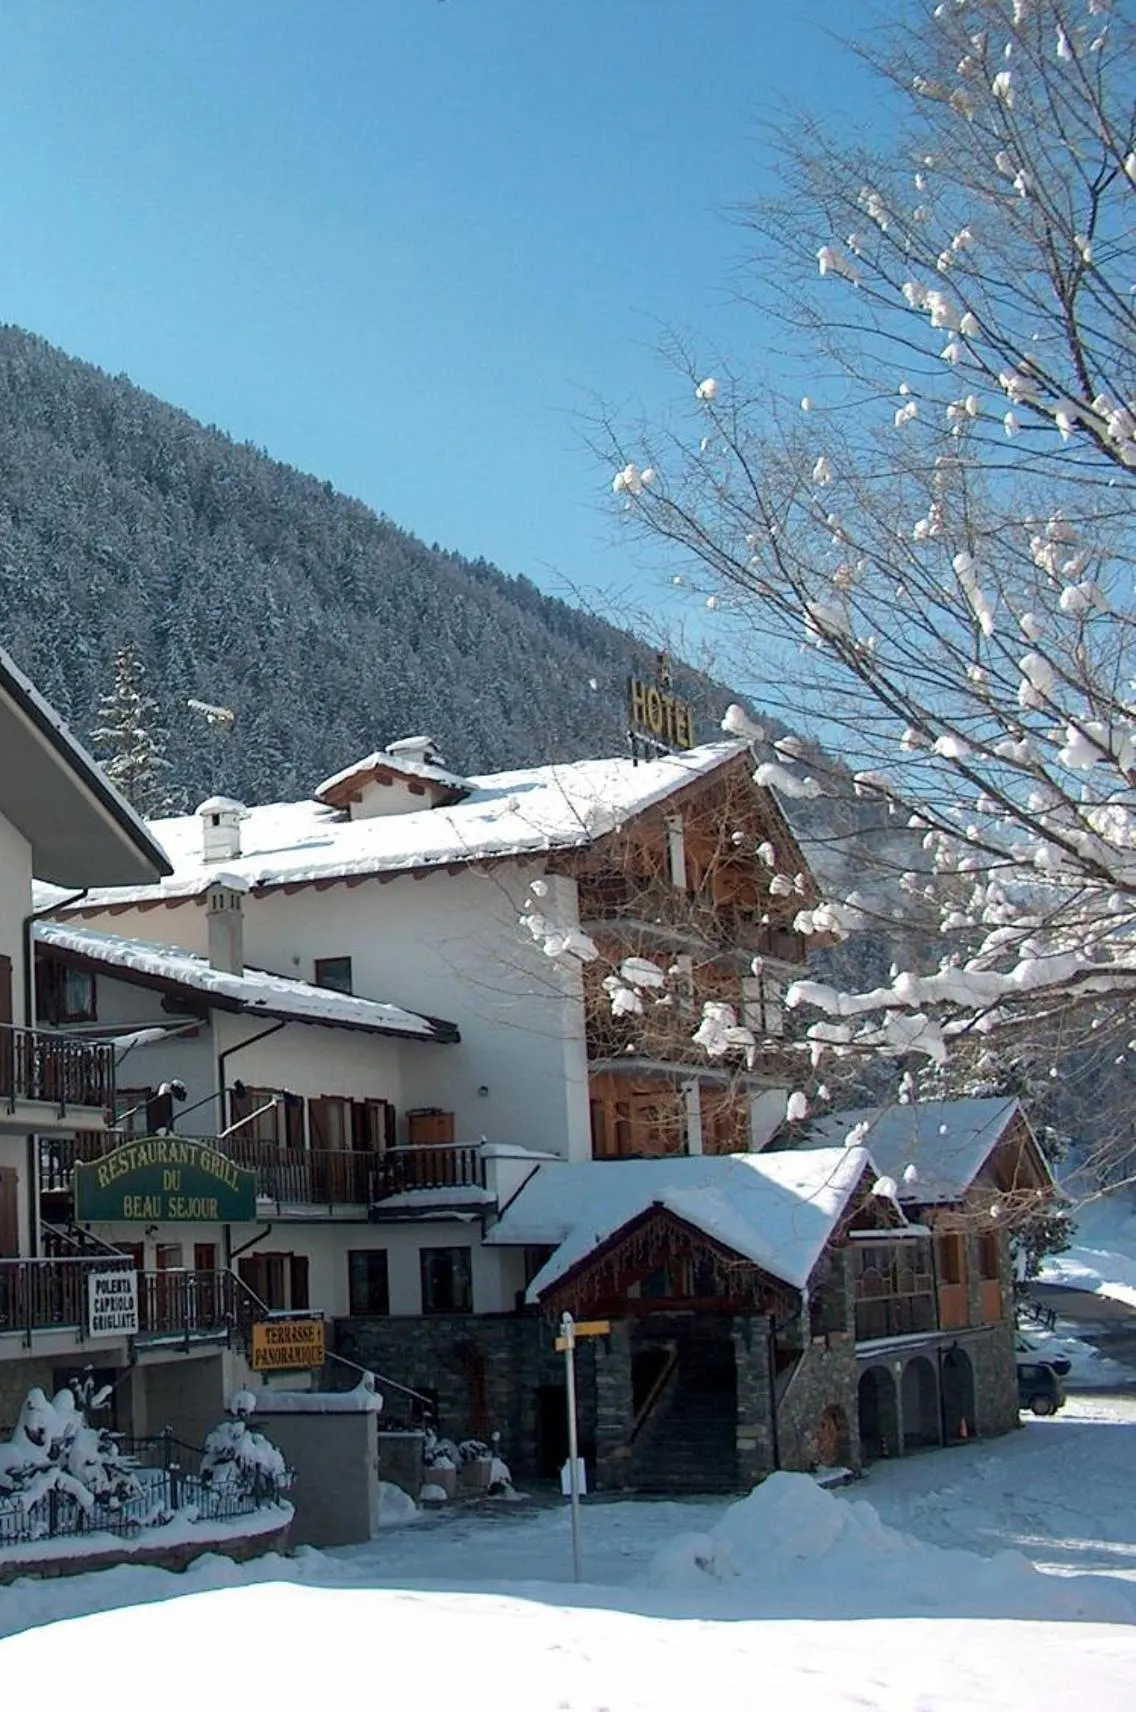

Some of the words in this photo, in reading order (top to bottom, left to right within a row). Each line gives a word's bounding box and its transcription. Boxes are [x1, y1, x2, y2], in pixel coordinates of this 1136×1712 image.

[631, 678, 695, 749] HOTEL
[97, 1141, 197, 1188] RESTAURANT
[200, 1148, 239, 1191] GRILL
[163, 1169, 181, 1191] DU
[123, 1195, 161, 1217] BEAU
[168, 1196, 218, 1218] SEJOUR
[96, 1278, 131, 1295] POLENTA
[94, 1295, 134, 1313] CAPRIOLO
[93, 1313, 136, 1331] GRIGLIATE
[265, 1325, 315, 1345] TERRASSE
[255, 1345, 323, 1366] PANORAMIQUE
